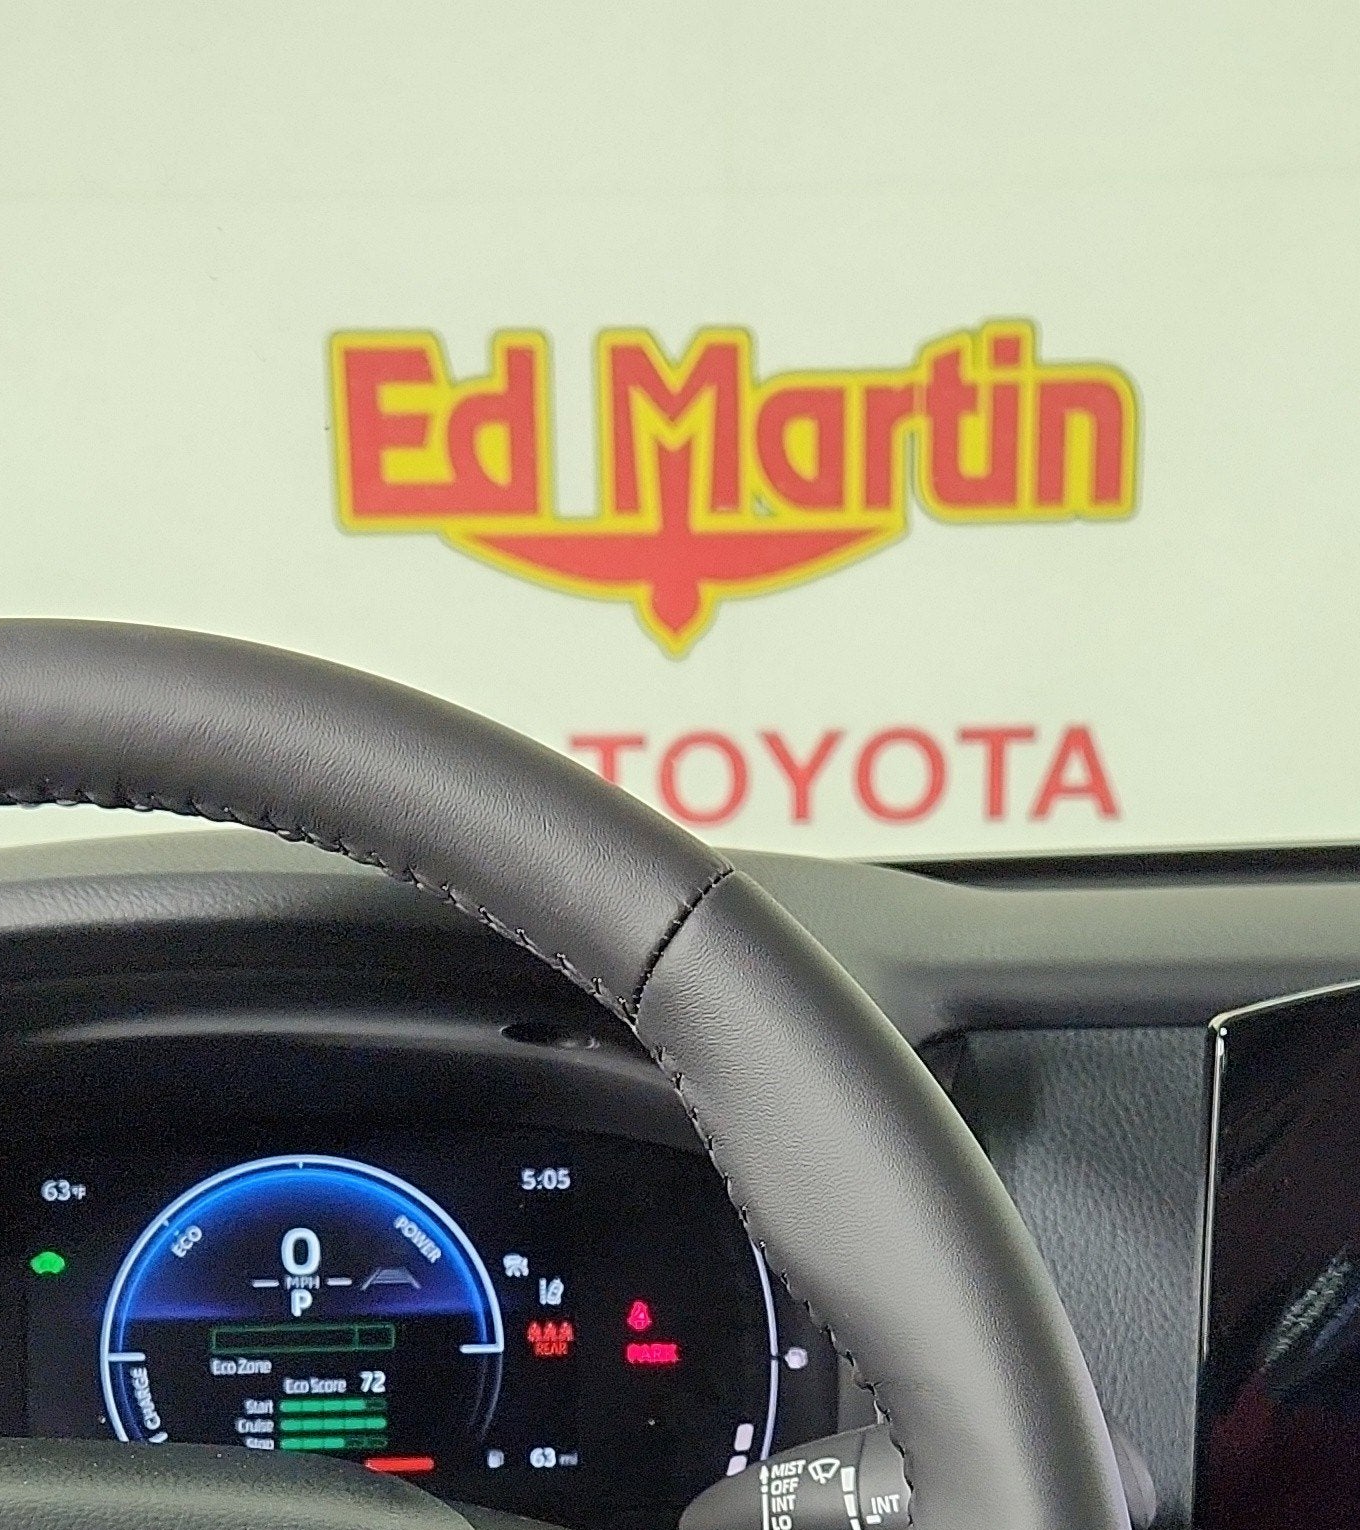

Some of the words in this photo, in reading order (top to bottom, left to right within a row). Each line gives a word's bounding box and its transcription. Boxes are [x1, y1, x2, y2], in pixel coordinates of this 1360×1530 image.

[335, 336, 545, 524] Ed
[602, 325, 1130, 520] Martin
[570, 722, 1123, 828] TOYOTA
[521, 1168, 570, 1190] 5:05
[170, 1225, 203, 1257] ECO
[394, 1215, 441, 1263] POWER
[286, 1276, 320, 1289] MPH
[290, 1289, 313, 1317] P
[211, 1359, 236, 1375] Eco
[238, 1358, 272, 1374] Zone
[284, 1379, 308, 1394] Eco
[310, 1377, 347, 1393] Score
[360, 1371, 386, 1393] 72
[130, 1367, 162, 1432] CHARGE
[236, 1419, 274, 1433] Cruise
[771, 1459, 806, 1477] MIST
[771, 1478, 799, 1495] OFF
[772, 1495, 796, 1512] INT
[871, 1495, 900, 1515] INT
